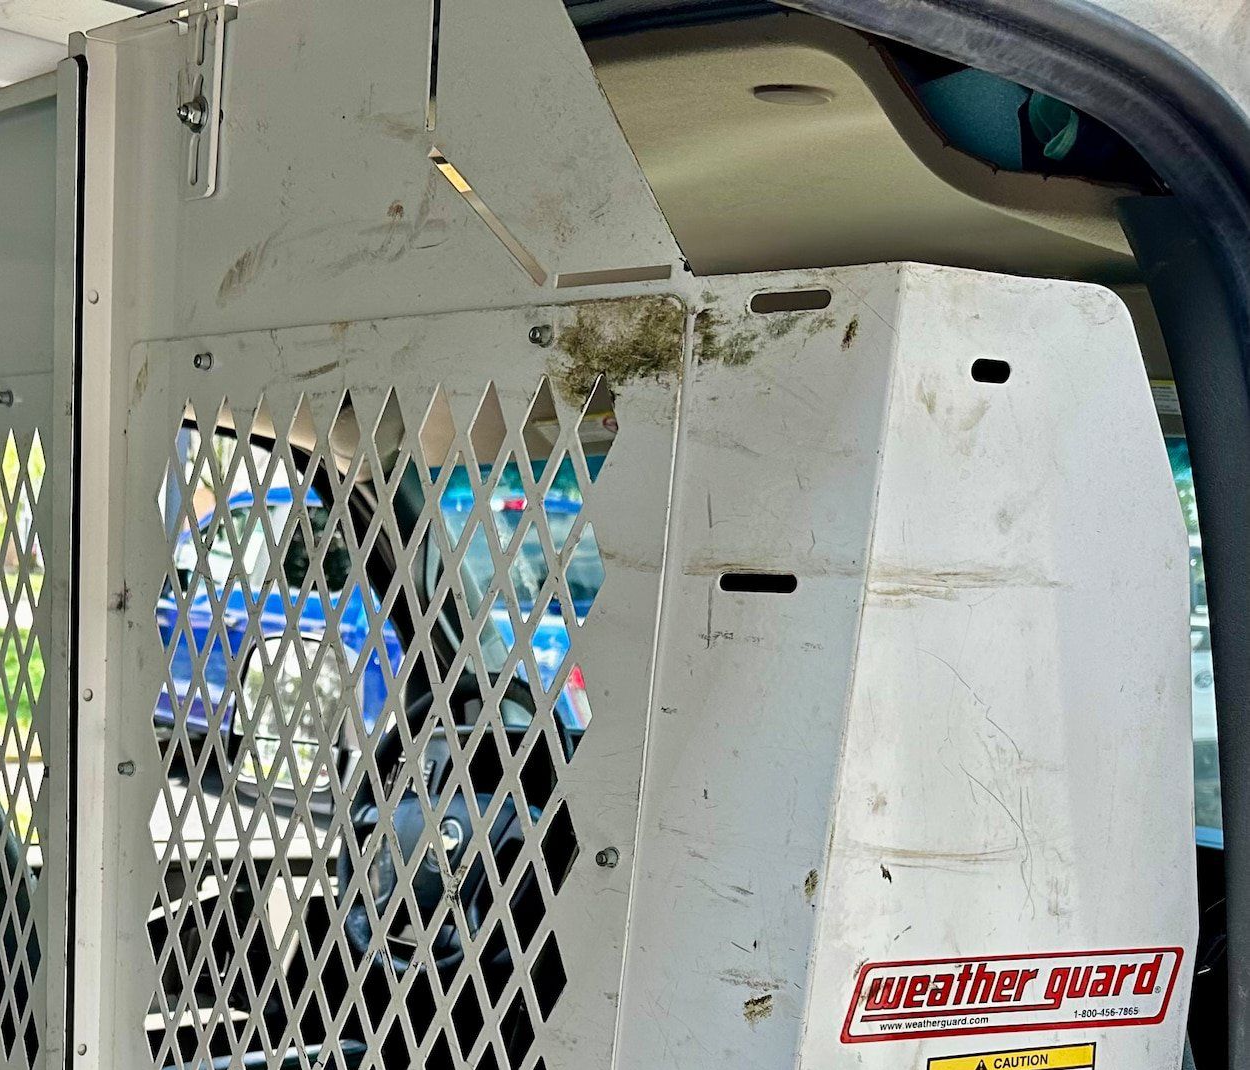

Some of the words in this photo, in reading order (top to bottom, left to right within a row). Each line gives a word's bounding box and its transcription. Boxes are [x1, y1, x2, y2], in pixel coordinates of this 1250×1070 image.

[865, 963, 1039, 1010] weather
[1044, 954, 1163, 1009] guard
[1073, 1007, 1139, 1018] 1-800-456-7865
[879, 1016, 989, 1031] www.weatherguard.com
[993, 1053, 1048, 1070] CAUTION
